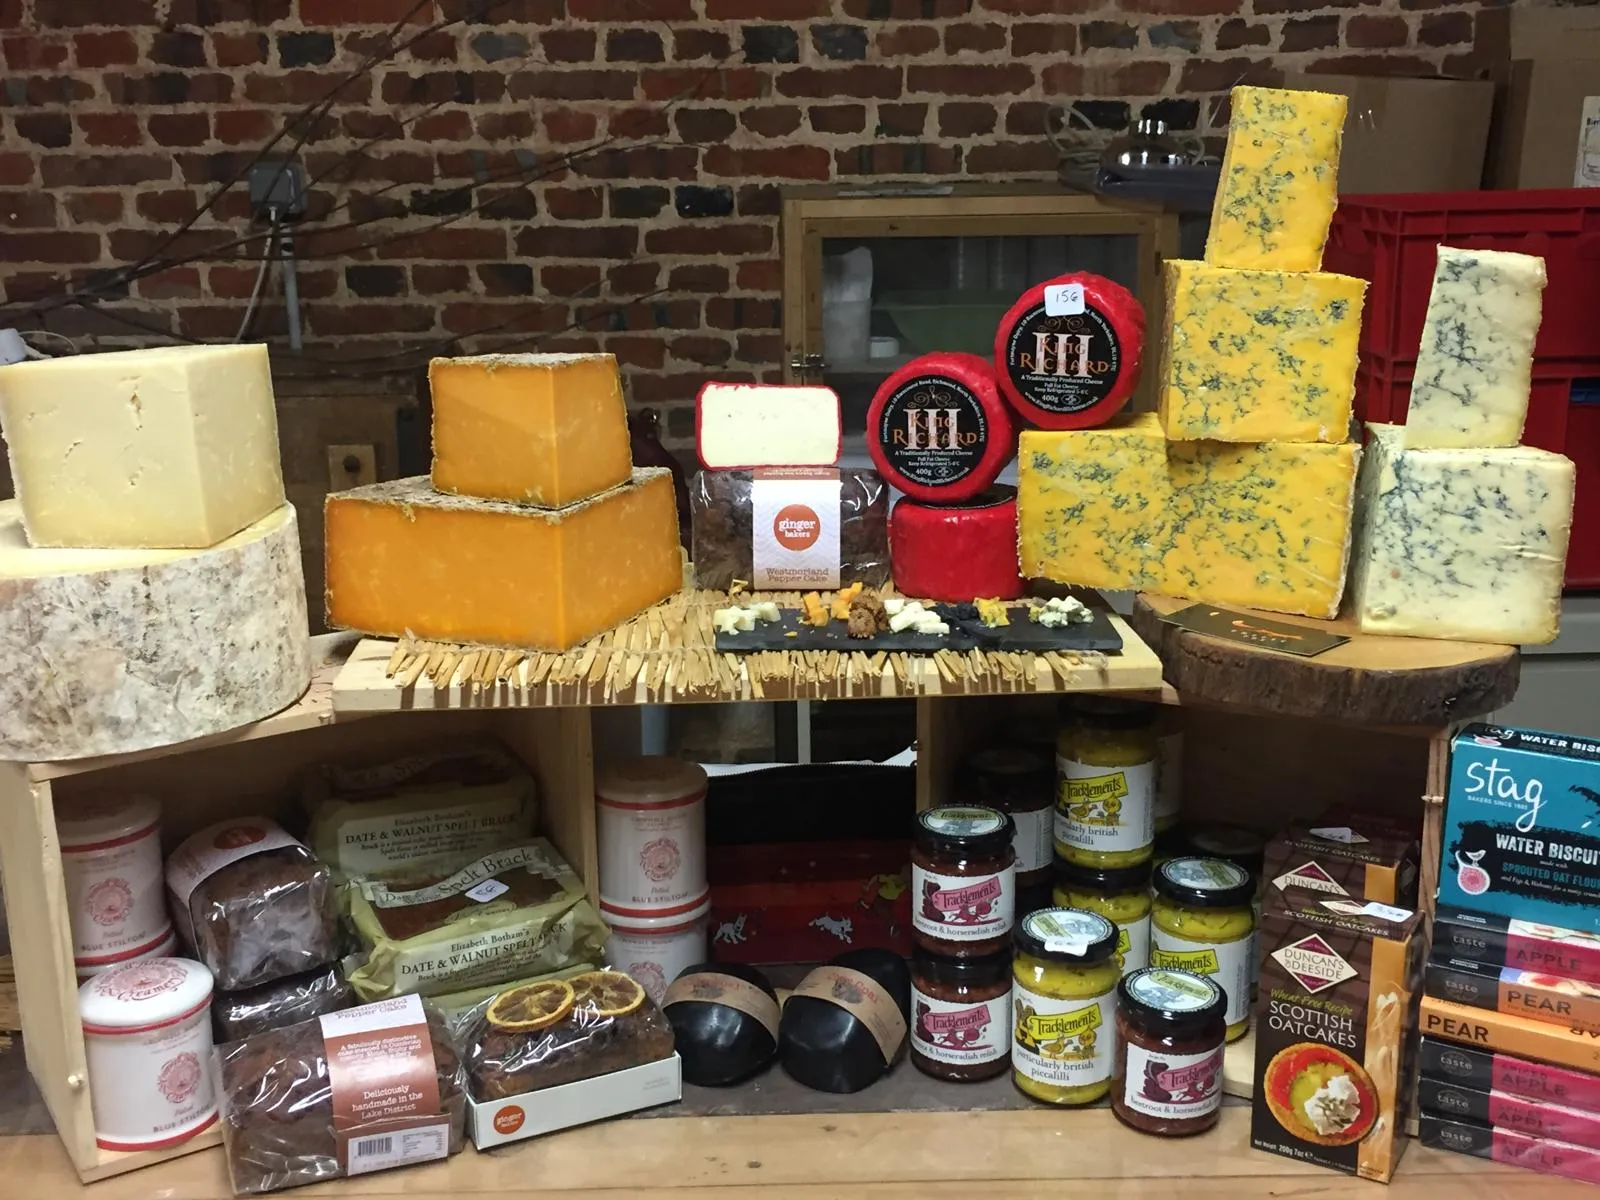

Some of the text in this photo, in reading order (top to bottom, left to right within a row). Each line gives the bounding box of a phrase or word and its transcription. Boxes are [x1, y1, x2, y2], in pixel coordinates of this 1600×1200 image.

[1026, 375, 1058, 383] Traditionally
[1041, 394, 1059, 403] 400g
[916, 468, 932, 477] 400g
[778, 518, 817, 532] ginger
[784, 530, 811, 538] bakers
[766, 567, 829, 576] Westmorland
[768, 574, 828, 584] Pepper Cake
[1520, 733, 1567, 748] WATER
[1066, 778, 1122, 800] Tracklements
[1465, 757, 1548, 833] stag
[1467, 795, 1512, 809] BAKERS SINCE
[346, 832, 377, 846] DATE
[380, 831, 388, 840] &
[392, 822, 442, 838] WALNUT
[444, 818, 476, 832] SPELT
[1088, 826, 1118, 837] british
[1332, 848, 1381, 863] OATCAKES
[1495, 832, 1600, 871] WATER BISCUI
[437, 848, 533, 893] Spelt Brack
[1502, 862, 1551, 882] SPROUTED
[1553, 870, 1572, 885] OAT
[632, 892, 689, 904] BLUE STILTON
[940, 880, 998, 909] Tracklements
[946, 925, 990, 938] horseradish
[1282, 910, 1390, 936] SCOTTISH OATCAKES
[450, 928, 531, 953] Elizabeth Botham's
[1452, 933, 1486, 949] taste
[402, 960, 435, 975] DATE
[437, 958, 448, 969] &
[449, 946, 501, 967] WALNUT
[1158, 954, 1213, 970] Tracklements
[1284, 948, 1346, 971] DUNCAN'S
[1516, 948, 1582, 972] APPLE
[1292, 960, 1343, 980] DEESIDE
[1446, 978, 1479, 994] taste
[1270, 988, 1300, 1003] Wheat
[1506, 989, 1572, 1017] PEAR
[336, 1003, 409, 1020] Pepper Cake
[931, 1010, 986, 1031] Tracklements
[1270, 1000, 1353, 1032] SCOTTISH
[1036, 1008, 1098, 1036] Tracklements
[1426, 1013, 1490, 1044] PEAR
[1268, 1016, 1357, 1049] OATCAKES
[934, 1048, 979, 1061] horseradish
[1016, 1047, 1094, 1071] particularly british
[1440, 1054, 1473, 1072] taste
[1031, 1066, 1071, 1081] piccalilli
[363, 1084, 410, 1100] Deliciously
[1500, 1071, 1568, 1097] APPLE
[352, 1091, 424, 1113] handmade in the
[1130, 1094, 1162, 1113] beetroot
[1164, 1105, 1170, 1113] &
[1437, 1093, 1470, 1110] taste
[361, 1102, 417, 1120] Lake District
[1440, 1128, 1473, 1145] taste
[1278, 1144, 1294, 1157] 200g
[1294, 1147, 1305, 1159] 7oz
[1500, 1144, 1565, 1169] APLE
